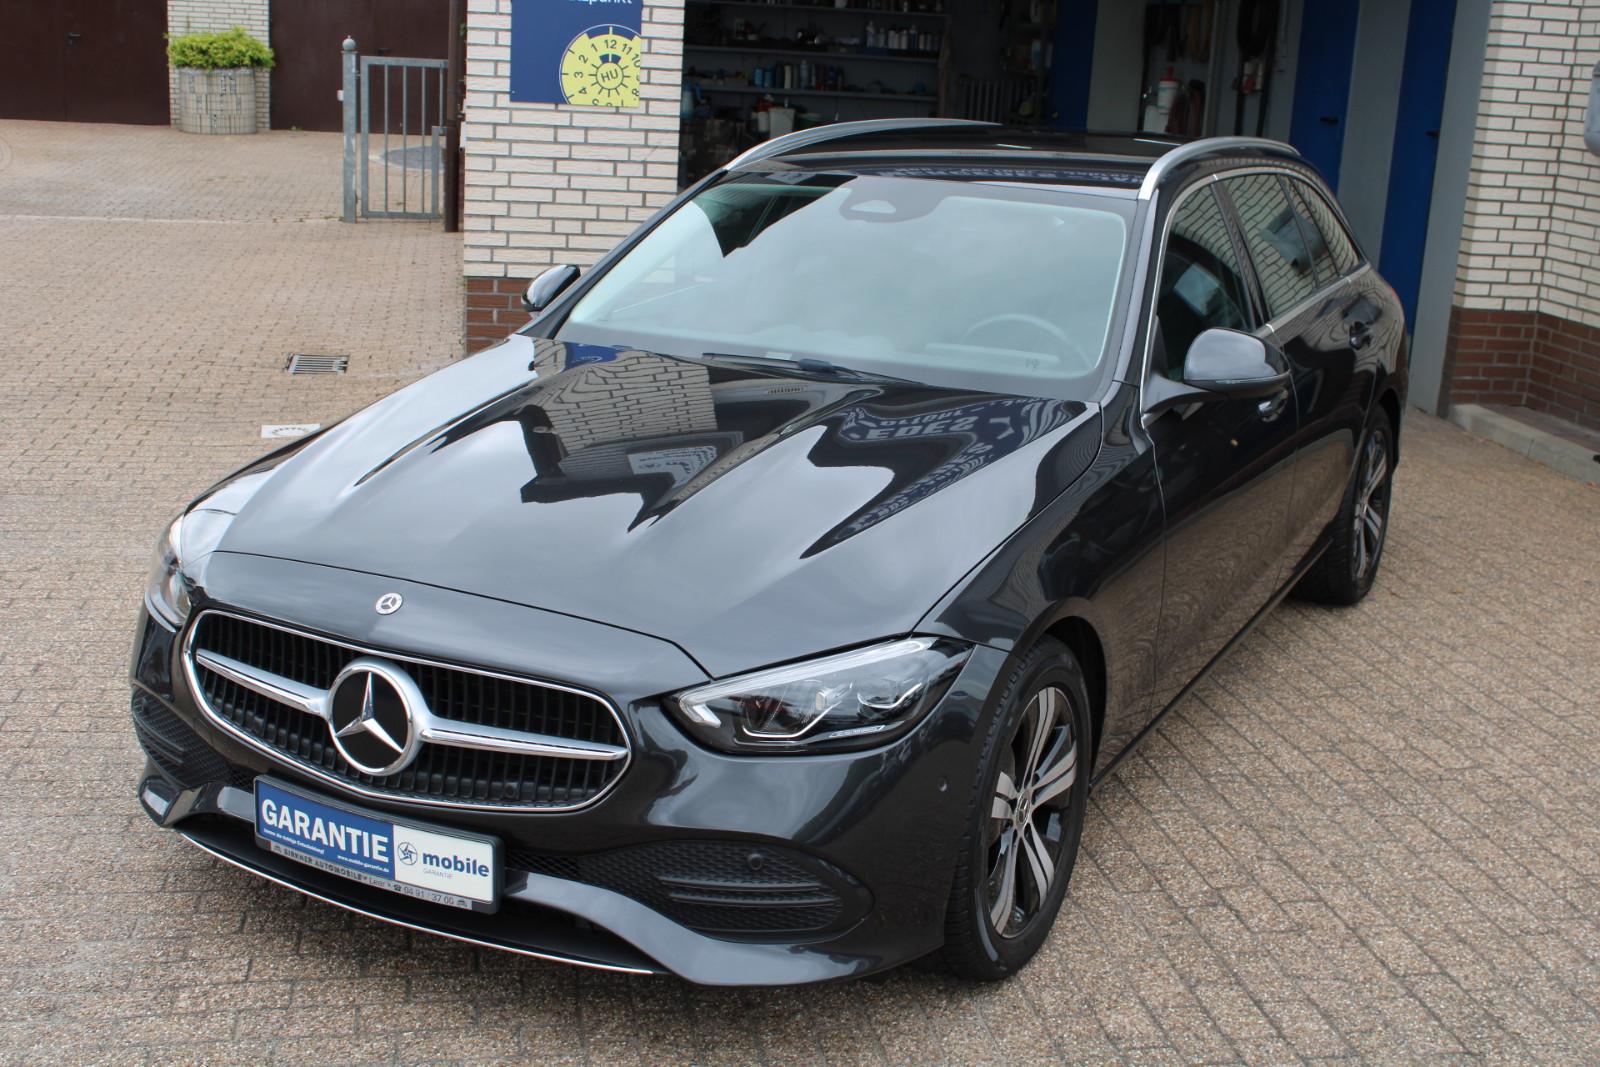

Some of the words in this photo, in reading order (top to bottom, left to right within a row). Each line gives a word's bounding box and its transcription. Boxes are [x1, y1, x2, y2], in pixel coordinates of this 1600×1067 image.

[604, 40, 617, 49] 12
[622, 44, 632, 55] 11
[578, 54, 588, 64] 2
[573, 71, 584, 79] 3
[600, 69, 619, 82] HU
[261, 798, 389, 863] GARANTIE
[422, 850, 490, 877] mobile
[315, 860, 364, 881] AUTOMOBILE
